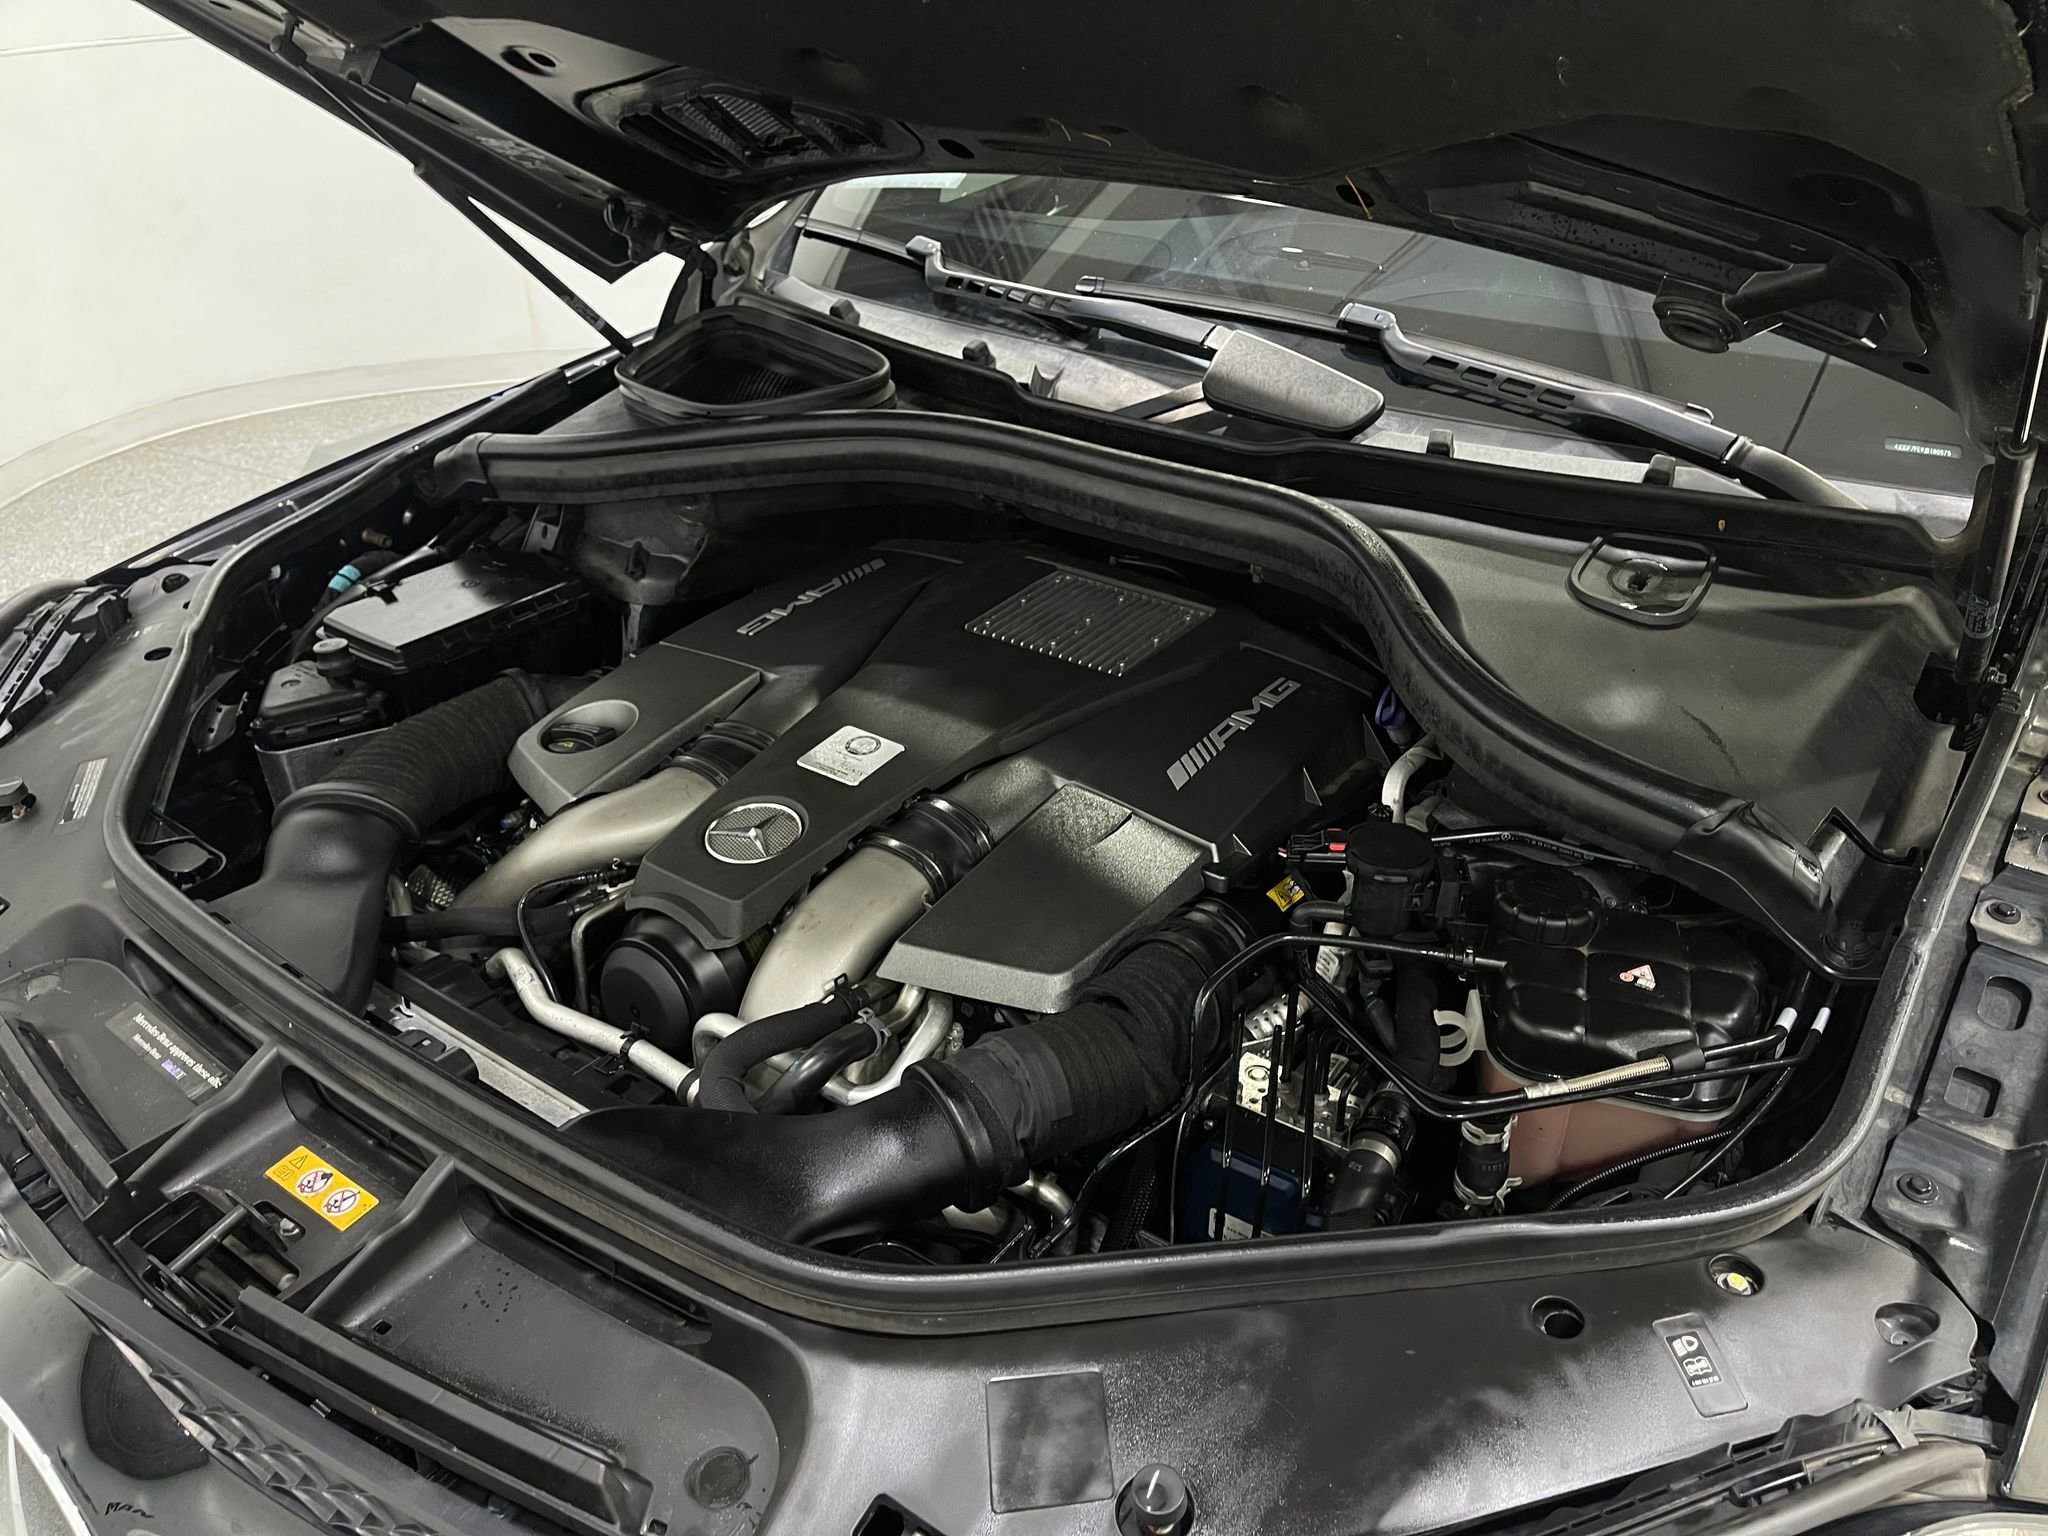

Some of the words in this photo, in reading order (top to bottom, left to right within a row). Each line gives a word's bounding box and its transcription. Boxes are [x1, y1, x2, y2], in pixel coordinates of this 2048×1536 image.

[736, 576, 843, 636] AMG
[133, 1012, 173, 1048] Mercedes-Benz
[169, 1045, 196, 1067] approves
